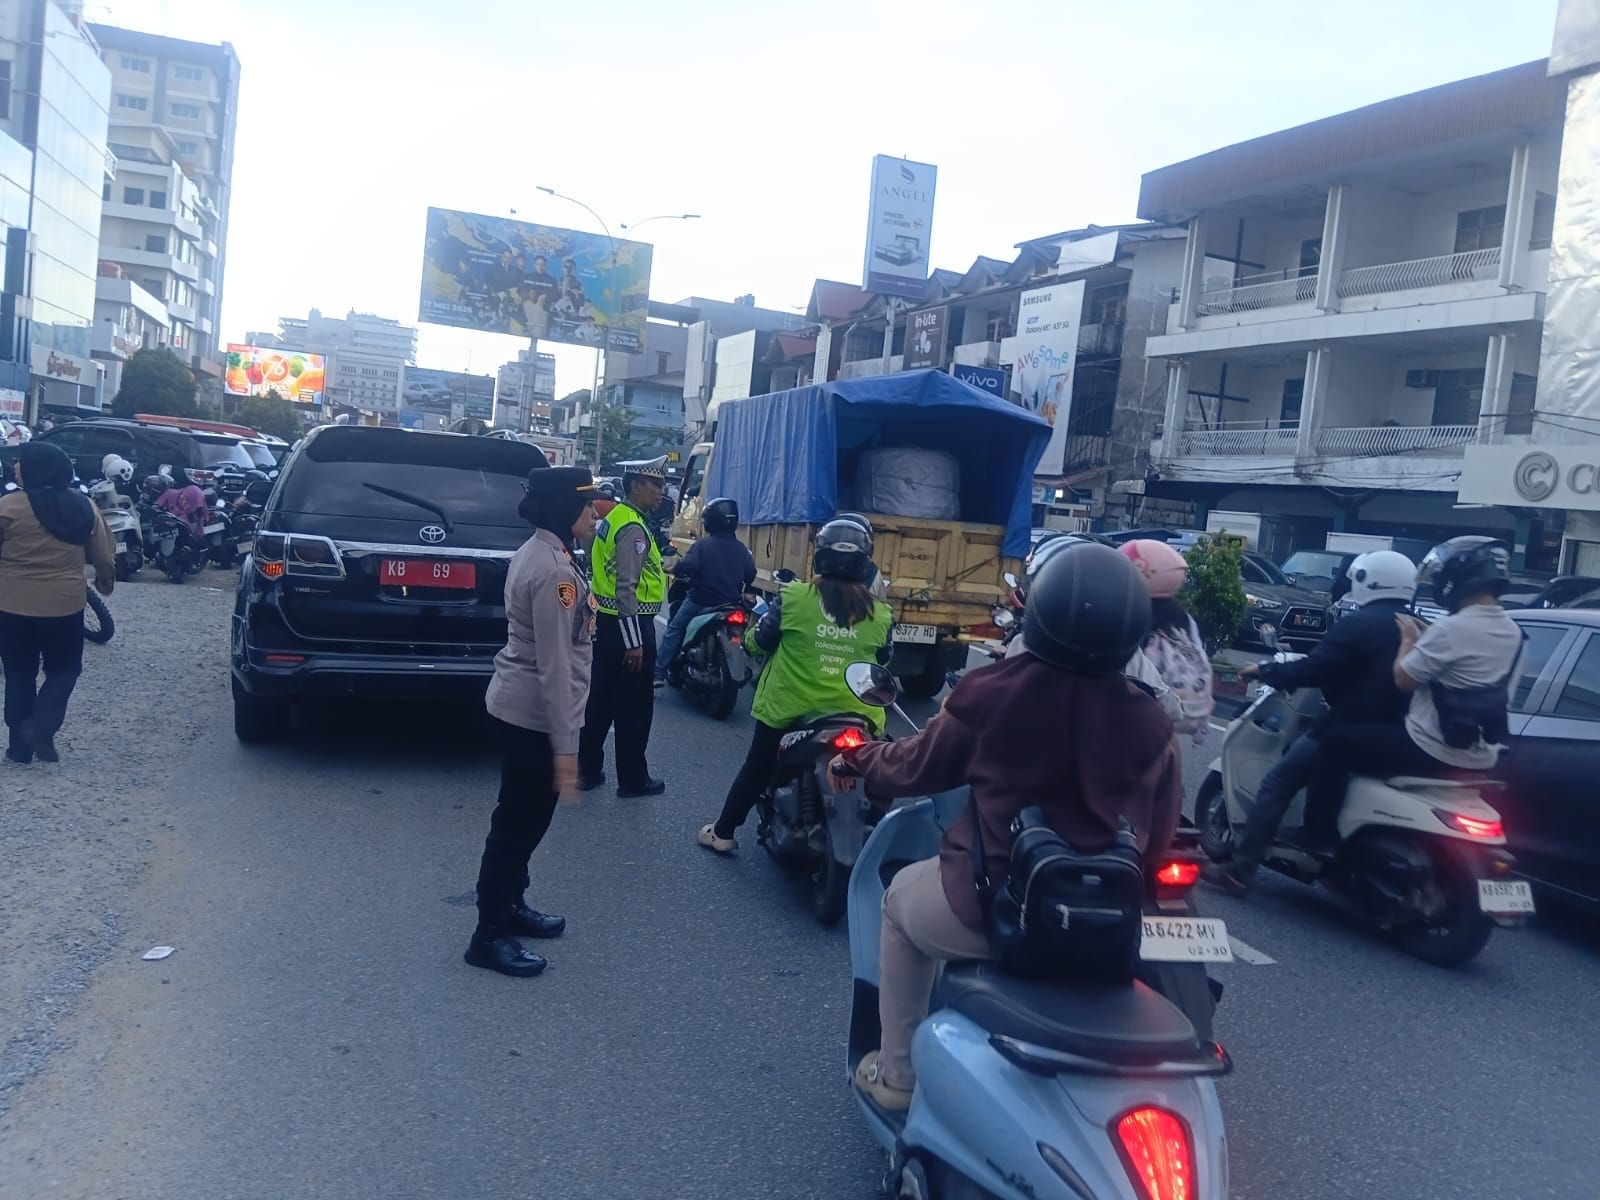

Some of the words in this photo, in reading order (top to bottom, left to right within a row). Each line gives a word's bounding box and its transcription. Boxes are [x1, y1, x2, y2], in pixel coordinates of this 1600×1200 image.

[881, 185, 928, 202] ANGEL
[1023, 293, 1052, 306] SAMSUNG
[960, 372, 998, 388] vivo
[388, 561, 406, 577] KB
[433, 563, 450, 578] 69
[816, 624, 858, 639] gojek
[815, 641, 854, 654] tokopedia
[820, 654, 846, 665] gopay
